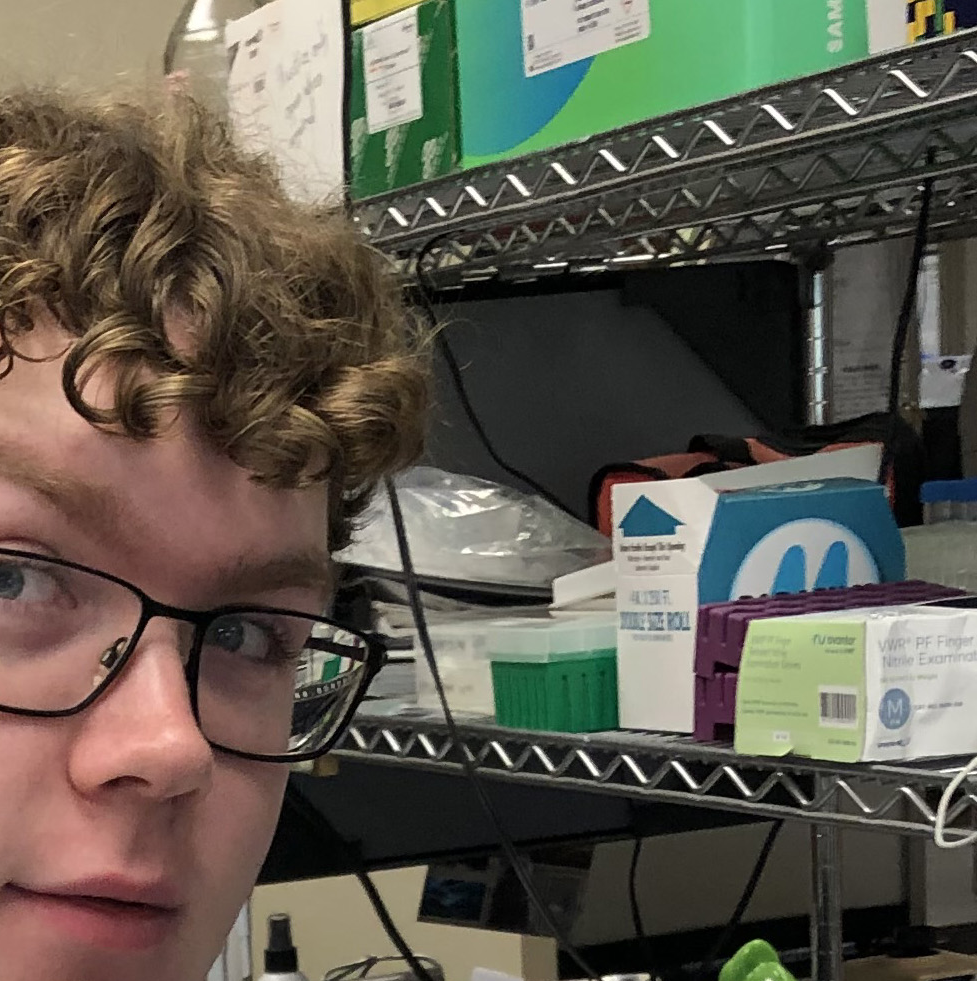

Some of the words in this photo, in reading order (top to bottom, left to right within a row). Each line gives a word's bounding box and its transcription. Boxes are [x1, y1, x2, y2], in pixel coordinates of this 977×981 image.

[916, 636, 933, 650] PF
[937, 634, 974, 650] Finger
[887, 699, 903, 718] M
